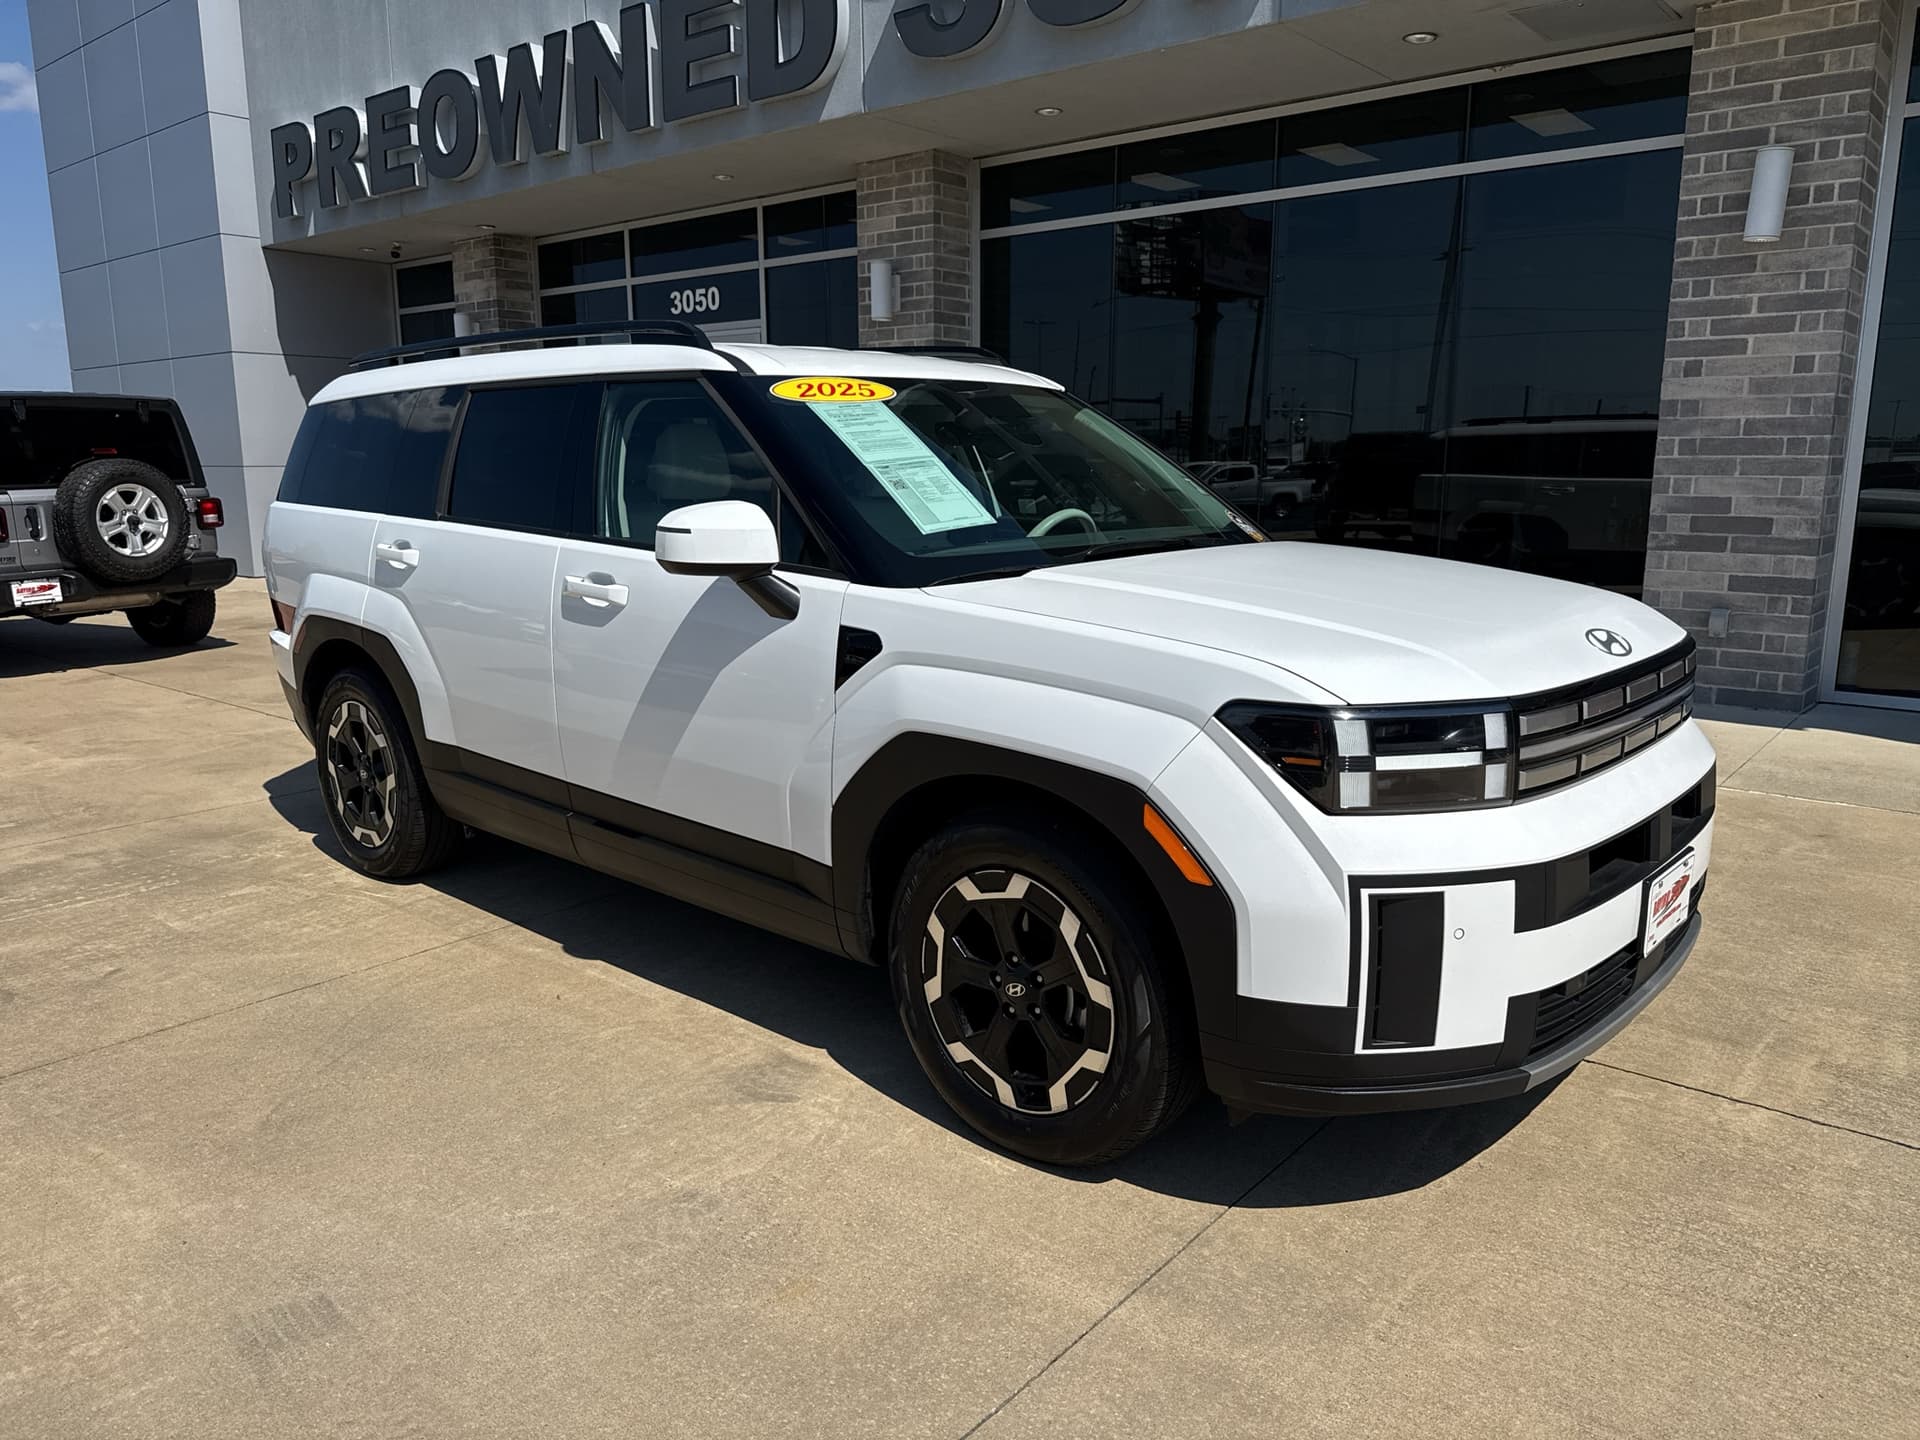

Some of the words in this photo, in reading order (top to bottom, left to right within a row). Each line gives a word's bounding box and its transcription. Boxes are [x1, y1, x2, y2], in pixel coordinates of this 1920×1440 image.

[270, 0, 846, 218] PREOWNED
[670, 286, 720, 315] 3050
[796, 382, 876, 398] 2025
